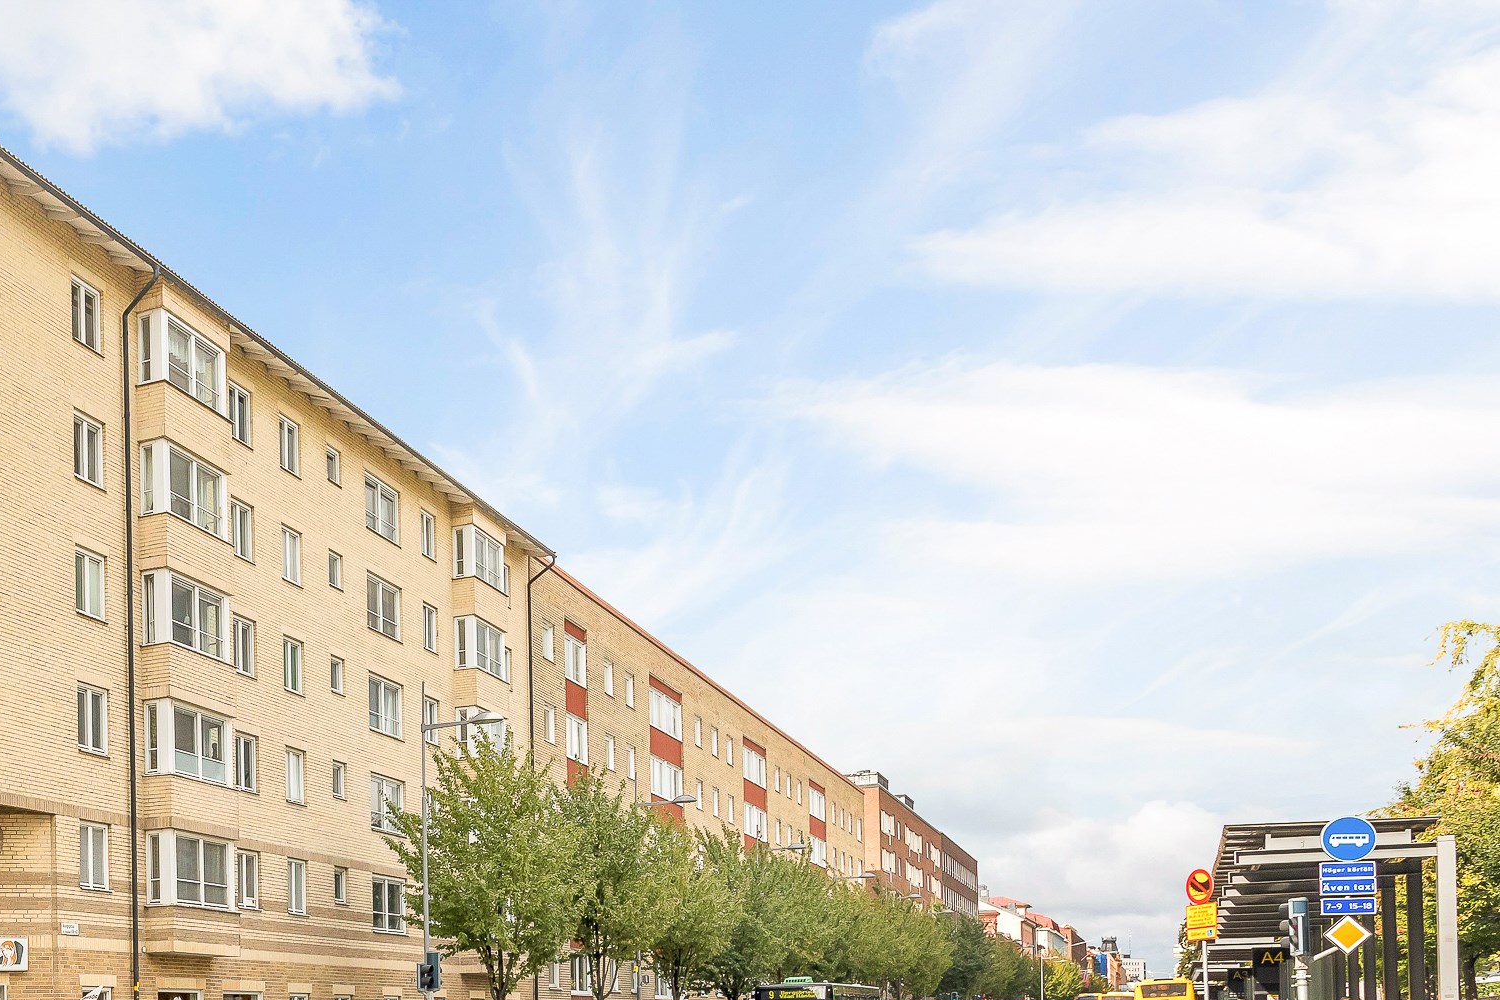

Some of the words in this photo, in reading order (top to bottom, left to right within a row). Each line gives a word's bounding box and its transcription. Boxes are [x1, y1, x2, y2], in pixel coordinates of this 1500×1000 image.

[1322, 866, 1345, 874] Höger
[1323, 883, 1350, 891] Även
[1353, 883, 1375, 891] taxi
[1261, 951, 1285, 965] A4
[1233, 970, 1249, 979] A3
[768, 990, 775, 999] 9
